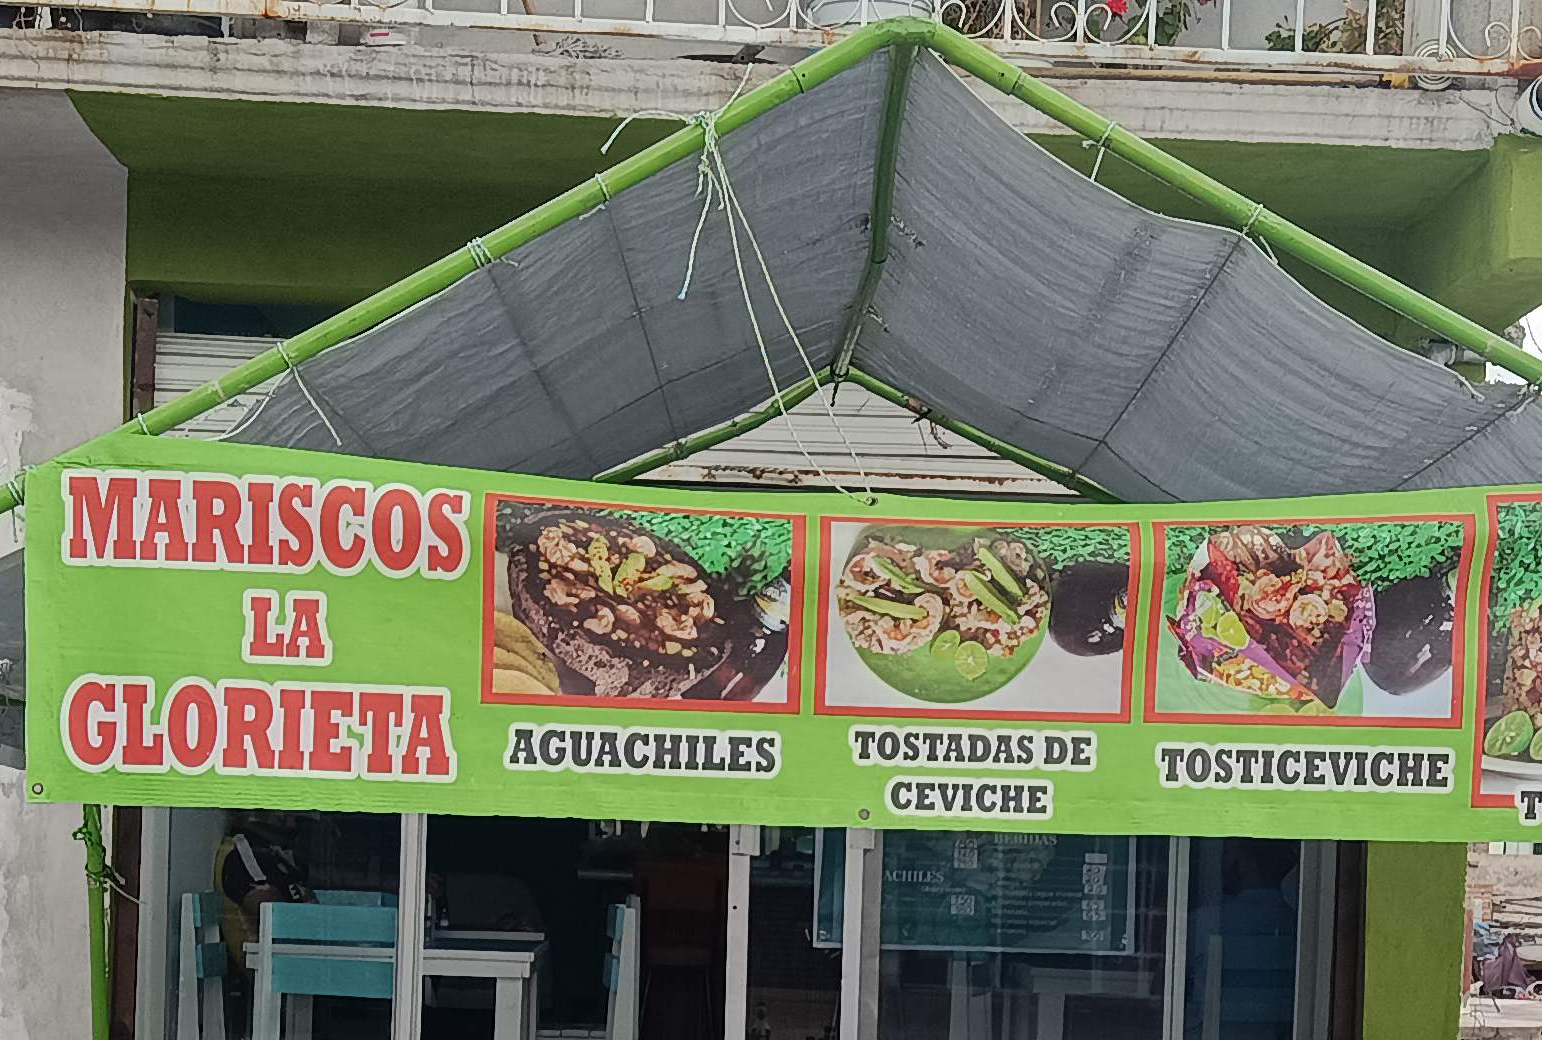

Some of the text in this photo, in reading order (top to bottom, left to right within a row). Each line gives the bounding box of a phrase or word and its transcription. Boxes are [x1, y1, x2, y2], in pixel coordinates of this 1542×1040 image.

[69, 476, 464, 573] MARISCOS
[250, 596, 326, 658] LA
[68, 682, 450, 775] GLORIETA
[509, 728, 777, 773] AGUACHILES
[854, 730, 1092, 766] TOSTADAS DE
[1160, 748, 1451, 788] TOSTICEVICHE
[889, 781, 1048, 814] CEVICHE
